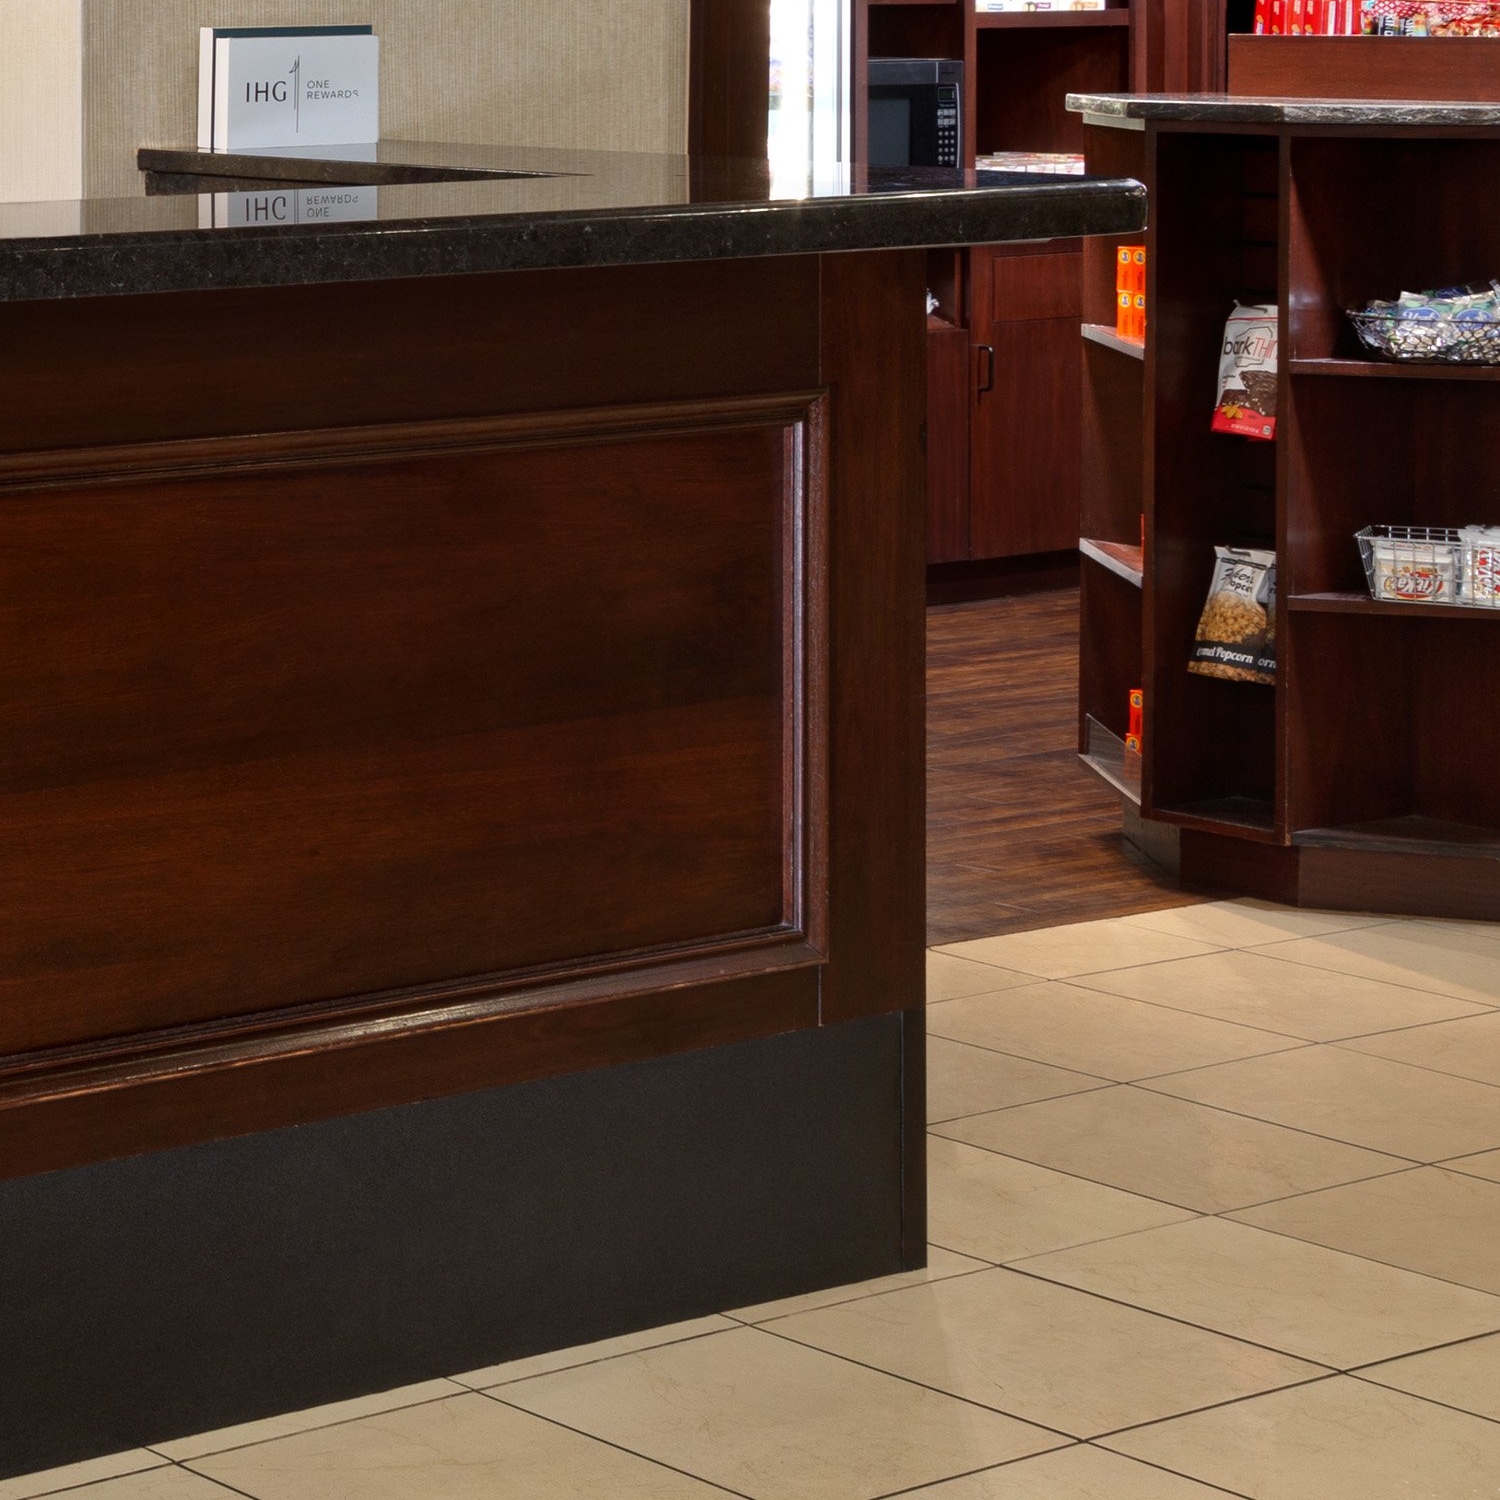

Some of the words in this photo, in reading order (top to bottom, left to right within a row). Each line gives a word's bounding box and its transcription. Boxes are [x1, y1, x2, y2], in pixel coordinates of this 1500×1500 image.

[306, 79, 330, 89] ONE
[245, 81, 287, 102] IHG
[306, 90, 359, 100] REWARDS
